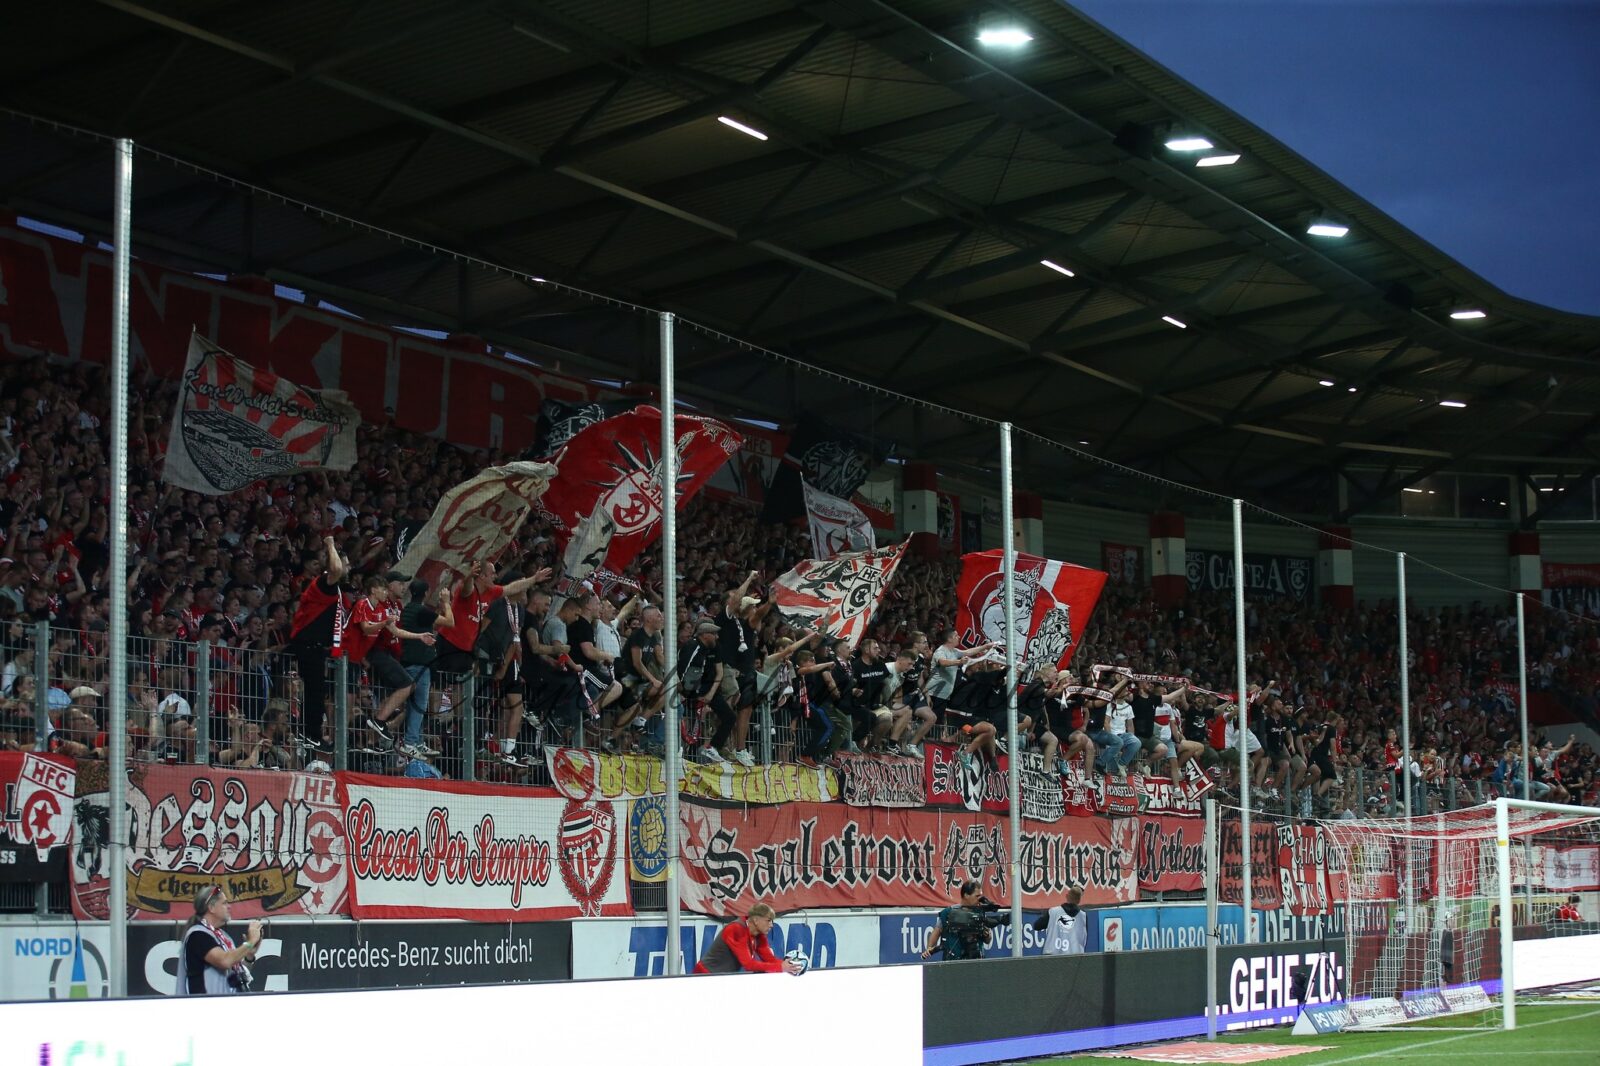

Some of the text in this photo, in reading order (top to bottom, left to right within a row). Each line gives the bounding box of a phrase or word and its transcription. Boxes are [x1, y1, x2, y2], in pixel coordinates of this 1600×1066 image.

[32, 762, 68, 790] HFC
[422, 807, 469, 885] Per
[468, 814, 551, 910] Sempre
[704, 817, 935, 900] Saalefront
[1019, 831, 1121, 895] Ultras
[158, 875, 221, 897] chem
[1330, 904, 1389, 933] AUTMATION
[15, 938, 72, 957] NORD
[1055, 939, 1070, 952] 09
[1178, 923, 1238, 949] BROKEN
[301, 938, 533, 969] Mercedes-Benz sucht dich!
